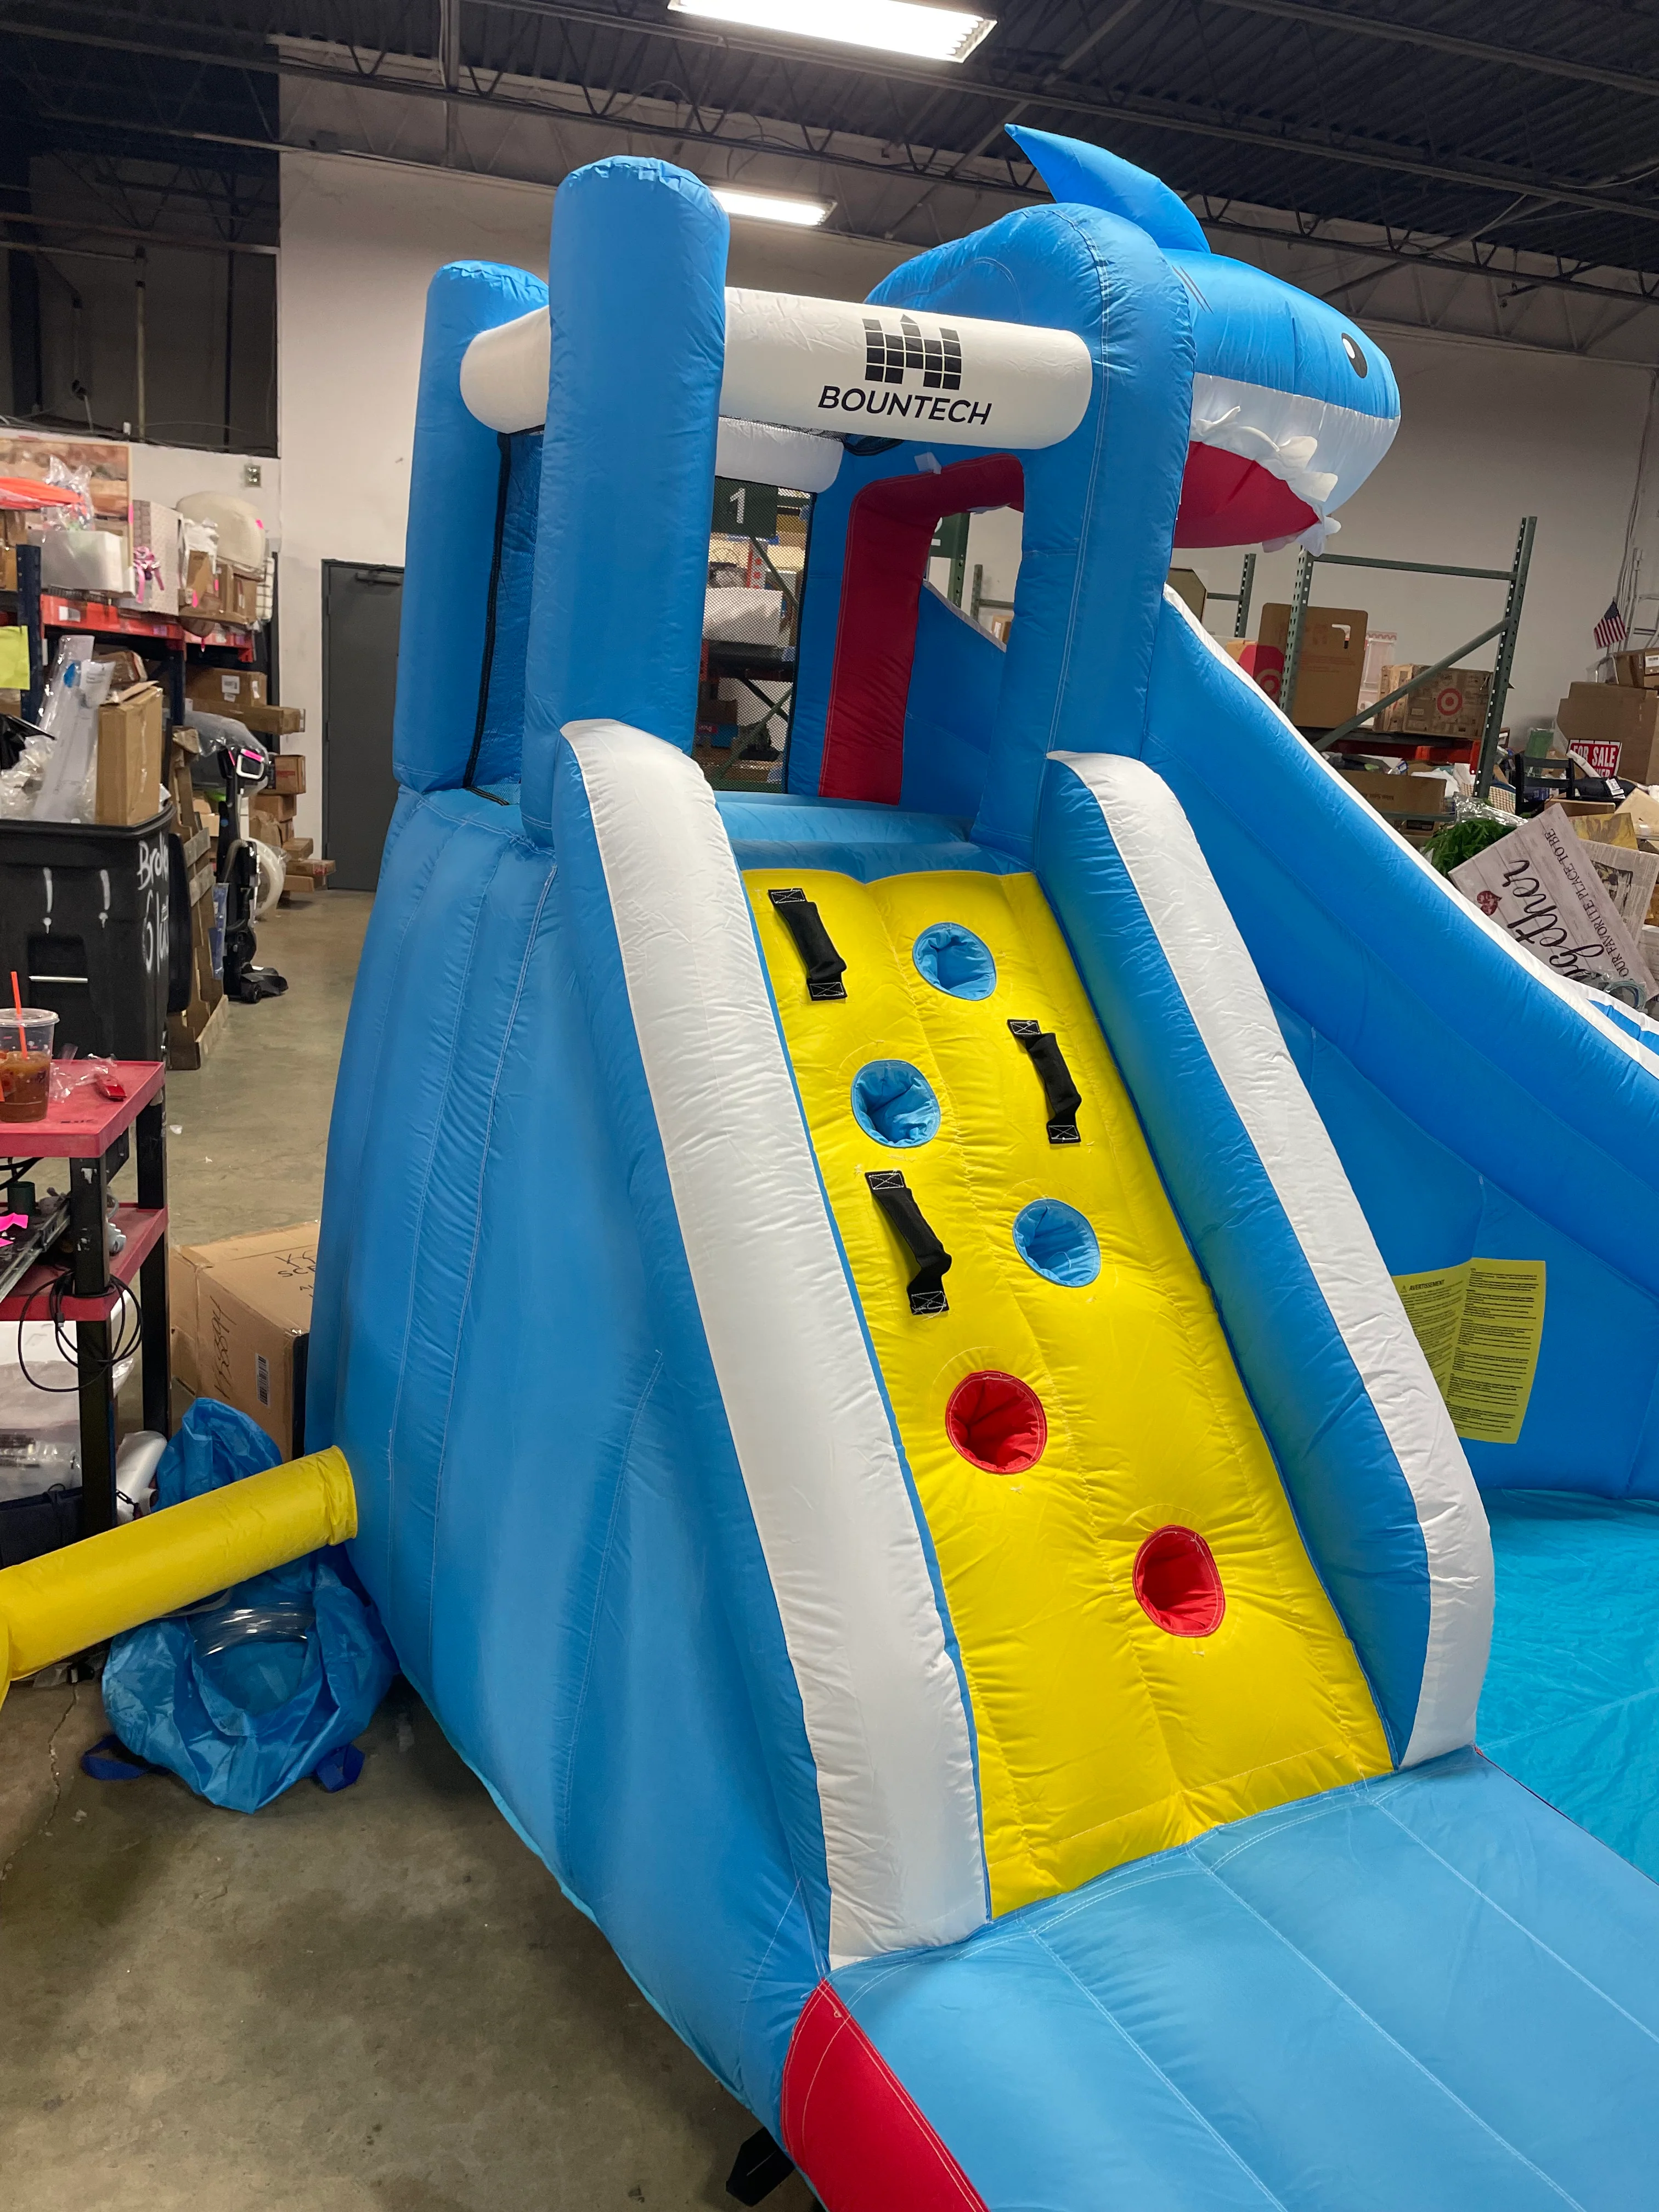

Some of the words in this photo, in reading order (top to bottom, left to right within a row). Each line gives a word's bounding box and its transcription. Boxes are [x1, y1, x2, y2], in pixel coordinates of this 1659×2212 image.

[817, 385, 992, 425] BOUNTECH
[729, 488, 746, 523] 1
[1592, 747, 1616, 768] SALE
[1544, 828, 1560, 848] BE
[1554, 847, 1569, 865] TO
[1564, 863, 1589, 900] PLACE
[1502, 860, 1604, 977] gether
[1583, 900, 1617, 955] FAVORITE
[1612, 952, 1629, 978] OUR
